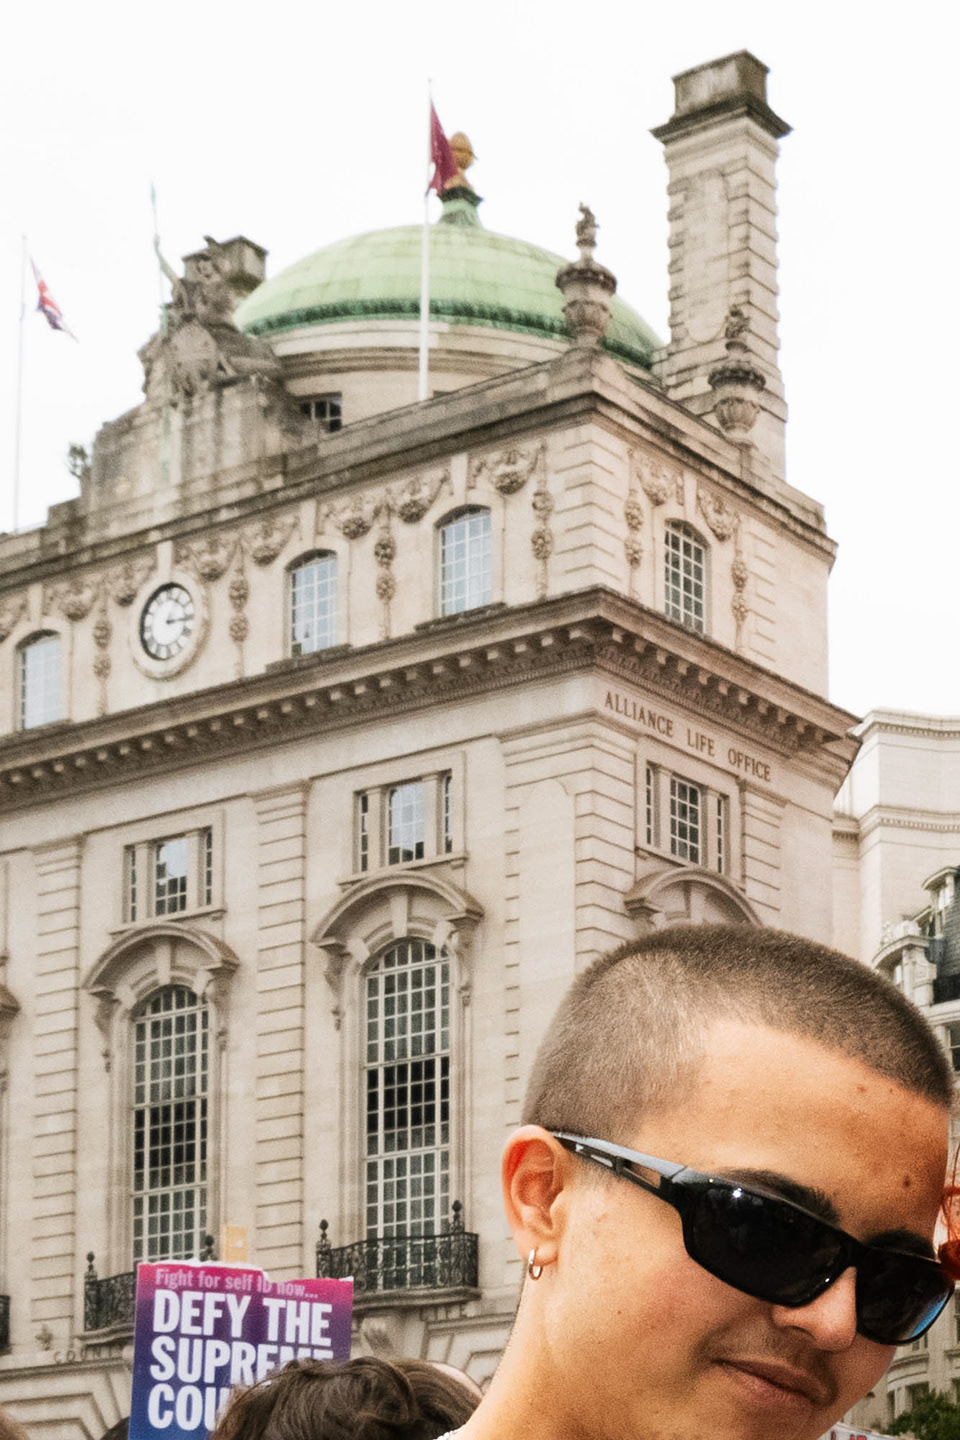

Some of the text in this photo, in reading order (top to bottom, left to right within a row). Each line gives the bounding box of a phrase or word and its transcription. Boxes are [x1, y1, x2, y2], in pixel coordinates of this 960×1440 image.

[605, 691, 771, 782] ALLIANCE LIFE OFFICE
[155, 1268, 194, 1290] Fight
[198, 1271, 221, 1288] for
[225, 1275, 253, 1291] self
[153, 1289, 332, 1346] DEFY THE
[150, 1335, 334, 1386] SUPRE
[148, 1383, 231, 1431] COU
